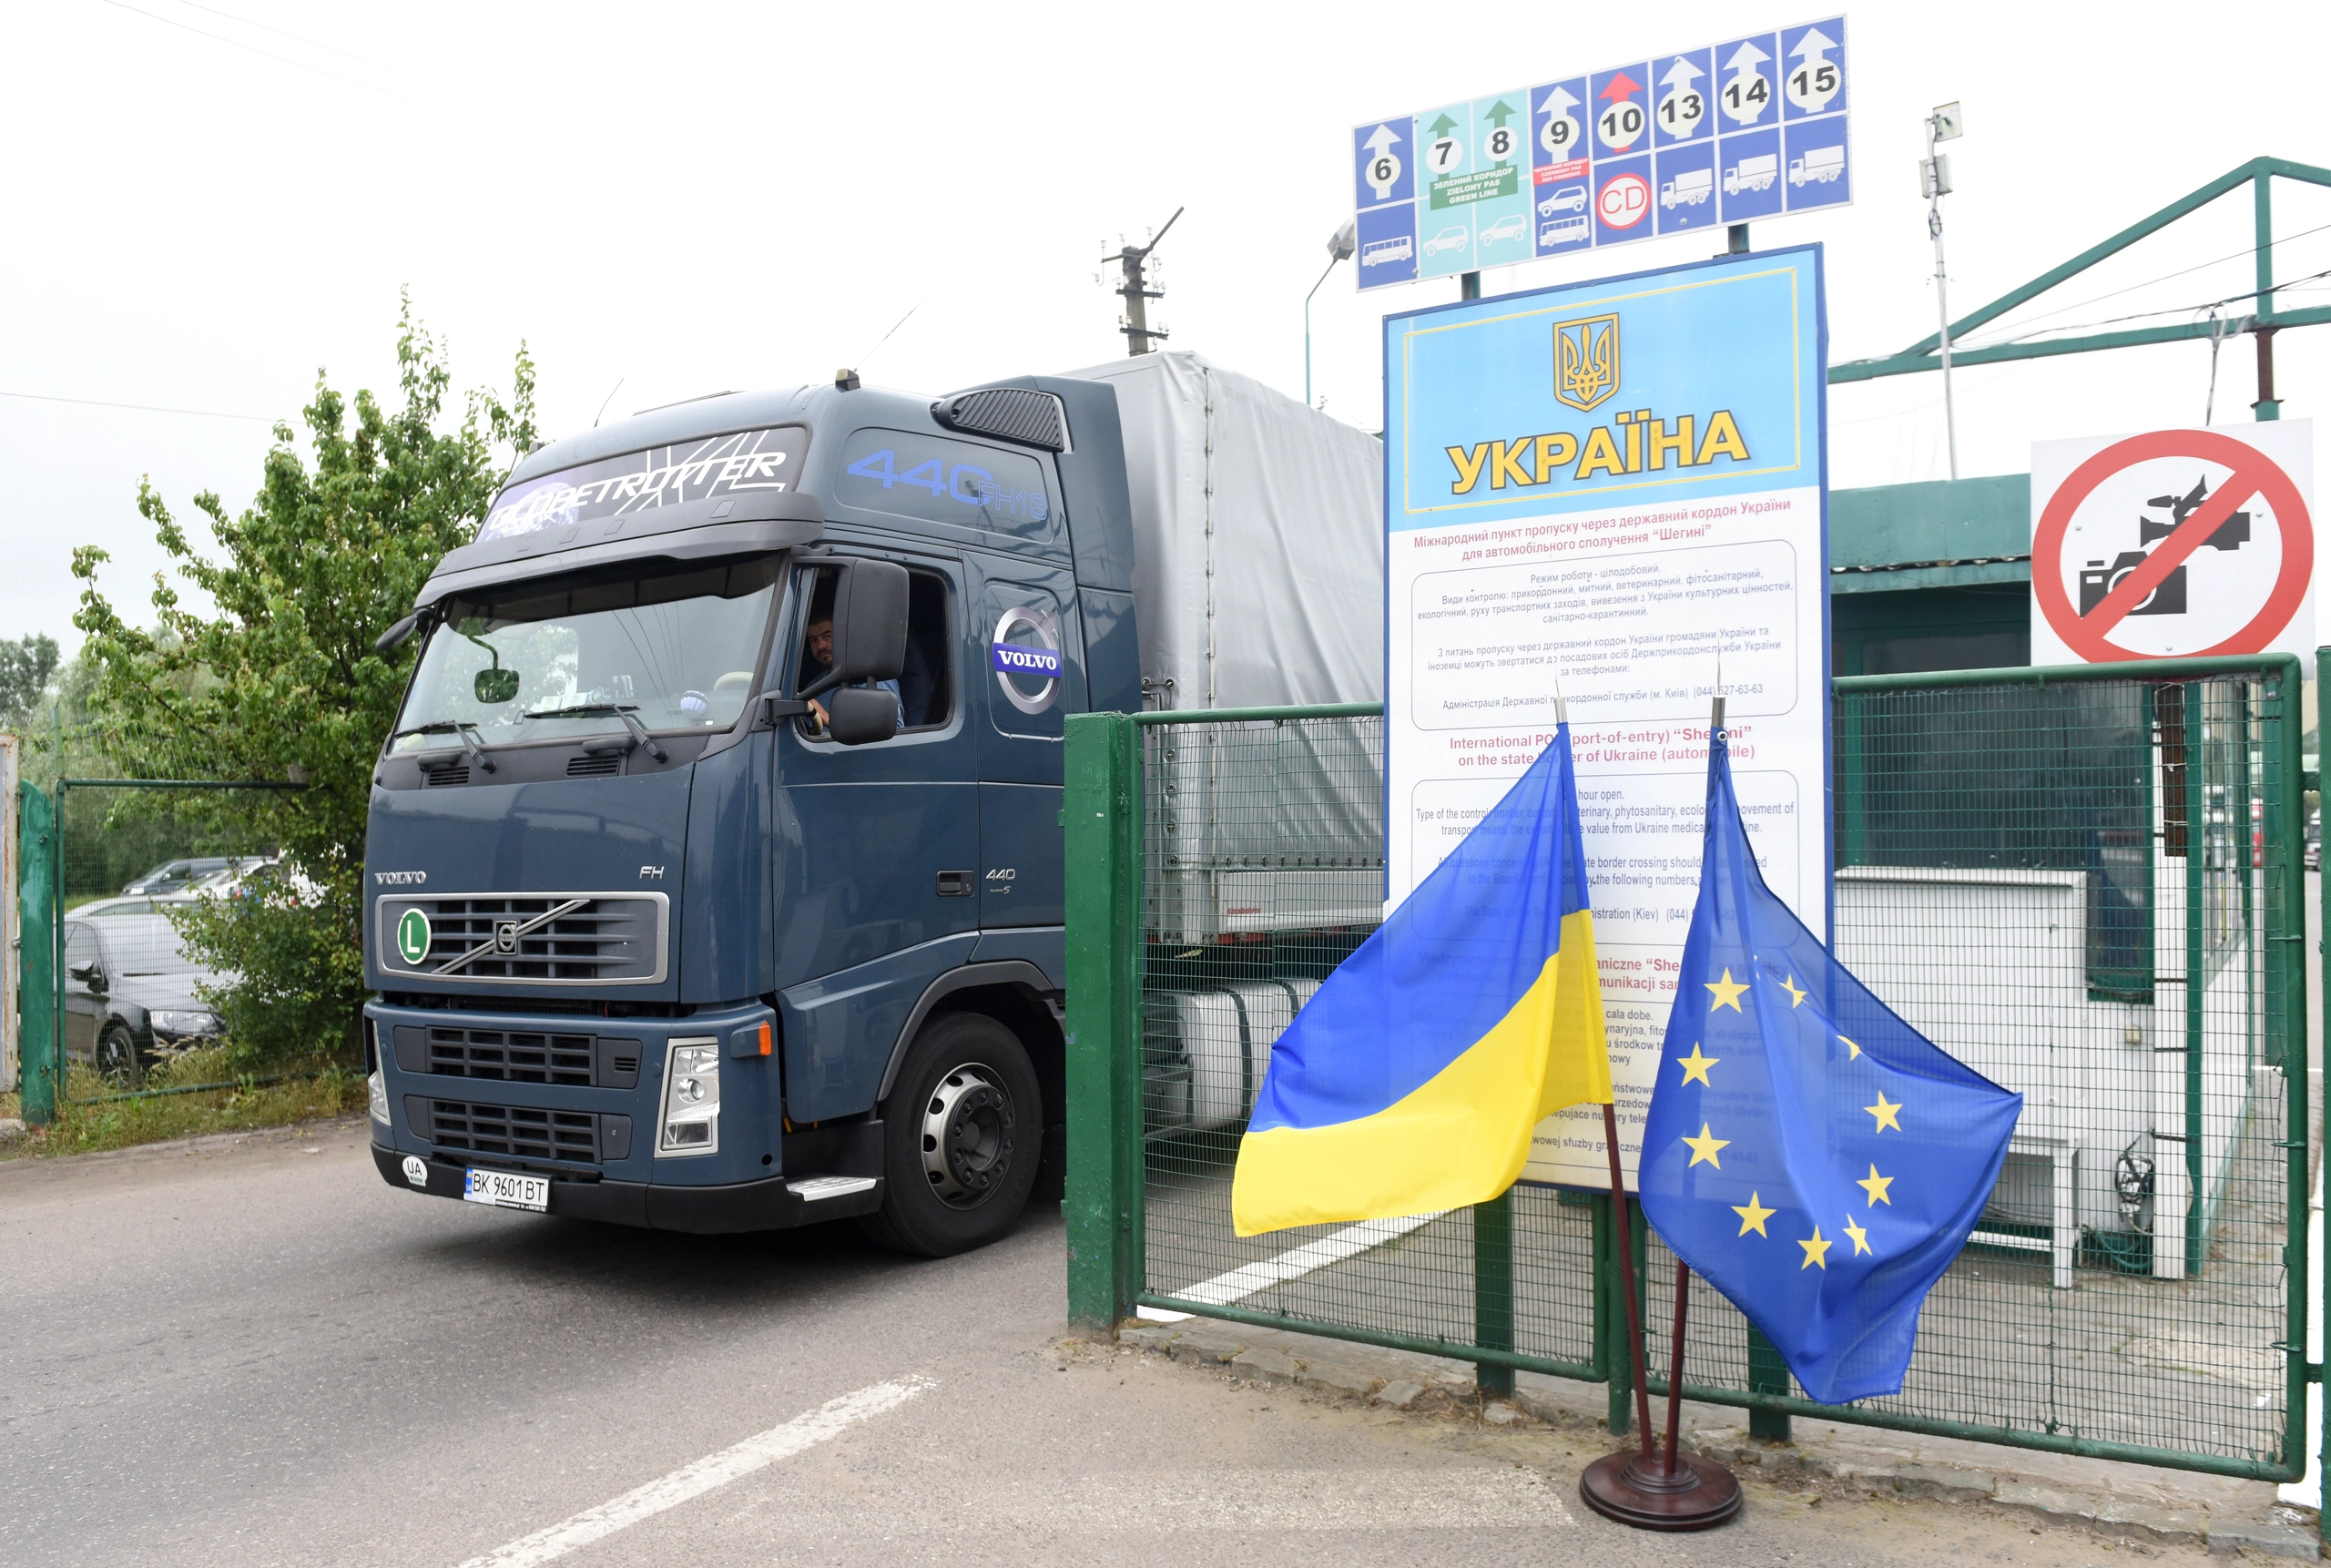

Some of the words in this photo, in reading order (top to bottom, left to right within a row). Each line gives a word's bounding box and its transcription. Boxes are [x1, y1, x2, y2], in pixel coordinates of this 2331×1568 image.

[1793, 66, 1837, 97] 15
[1725, 78, 1768, 109] 14
[1661, 94, 1701, 124] 13
[1550, 120, 1569, 145] 9
[1603, 108, 1643, 137] 10
[1491, 129, 1510, 155] 8
[1435, 141, 1453, 166] 7
[1374, 158, 1392, 180] 6
[1433, 176, 1472, 189] ЗЕЛЕНИЙ
[1474, 167, 1514, 182] КОРИДОР
[1446, 181, 1481, 196] ZIELONY
[1483, 178, 1501, 188] PAS
[1449, 192, 1477, 204] GREEN
[1479, 188, 1499, 199] LINE
[1603, 185, 1644, 215] CD
[1444, 408, 1752, 495] УКРАЇНА
[847, 449, 993, 506] 440
[488, 452, 787, 532] GLOBETROTTER
[978, 479, 1048, 521] FH13
[1414, 530, 1489, 548] Міжнародний
[1491, 528, 1522, 542] пункт
[1525, 522, 1579, 539] пропуску
[1582, 517, 1616, 531] через
[1619, 509, 1688, 528] державний
[1691, 504, 1737, 520] кордон
[1740, 499, 1790, 515] України
[1462, 549, 1482, 562] для
[1485, 540, 1575, 557] автомобільного
[1578, 532, 1648, 549] сполучення
[1531, 574, 1559, 584] Режим
[1561, 571, 1593, 584] роботи
[1600, 564, 1662, 579] цілодобовий.
[1441, 595, 1463, 606] Види
[1465, 592, 1509, 603] контролю:
[1512, 585, 1576, 599] прикордонний,
[1578, 582, 1614, 593] митний,
[1616, 575, 1684, 590] ветеринарний,
[1685, 568, 1763, 585] фітосанітарний,
[1418, 607, 1469, 620] екологічний,
[1471, 606, 1490, 617] руху
[1492, 601, 1551, 615] транспортних
[1552, 597, 1589, 609] заходів,
[1591, 595, 1638, 606] вивезення
[1647, 589, 1683, 603] України
[1685, 585, 1739, 600] культурних
[1742, 580, 1794, 594] цінностей,
[1542, 606, 1649, 623] санітарно-карантинний.
[1445, 647, 1474, 657] питань
[1476, 645, 1515, 657] пропуску
[1517, 643, 1541, 654] через
[1594, 636, 1626, 648] кордон
[1628, 634, 1664, 646] України
[1665, 630, 1716, 643] громадяни
[1719, 627, 1756, 639] України
[1758, 627, 1769, 636] та
[998, 649, 1057, 670] VOLVO
[1428, 659, 1461, 671] іноземці
[1463, 658, 1494, 670] можуть
[1497, 656, 1544, 668] звертатися
[1560, 650, 1607, 663] посадових
[1610, 648, 1628, 659] осіб
[1744, 639, 1781, 653] України
[1560, 667, 1569, 677] за
[1572, 664, 1630, 677] телефонами:
[1442, 697, 1500, 710] Адміністрація
[1501, 695, 1548, 708] Державної
[1550, 691, 1612, 706] пкордонної
[1613, 691, 1647, 703] служби
[1450, 734, 1531, 750] International
[1458, 757, 1474, 767] on
[1477, 754, 1498, 766] the
[1501, 752, 1533, 765] state
[1586, 750, 1600, 762] of
[1603, 748, 1657, 761] Ukraine
[1578, 789, 1598, 800] hour
[1601, 790, 1624, 803] open.
[1416, 808, 1435, 821] Type
[1436, 808, 1445, 820] of
[1446, 808, 1459, 820] the
[1614, 804, 1677, 820] phytosanitary,
[1739, 802, 1782, 815] ovement
[1785, 802, 1794, 814] of
[1586, 821, 1610, 834] value
[1612, 821, 1633, 834] from
[1635, 821, 1669, 834] Ukraine
[639, 865, 665, 880] FH
[1597, 856, 1626, 868] border
[1628, 857, 1668, 871] crossing
[1670, 855, 1702, 868] should
[374, 871, 426, 885] VOLVO
[985, 869, 1016, 881] 440
[1596, 873, 1610, 885] the
[1613, 872, 1653, 889] following
[1633, 907, 1659, 922] (Kiev)
[1666, 907, 1689, 922] (044)
[407, 920, 420, 953] L
[1606, 1009, 1624, 1019] cala
[1627, 1009, 1654, 1021] dobe.
[407, 1160, 422, 1176] UA
[473, 1173, 490, 1195] BK
[494, 1176, 522, 1199] 9601
[526, 1180, 545, 1202] BT
